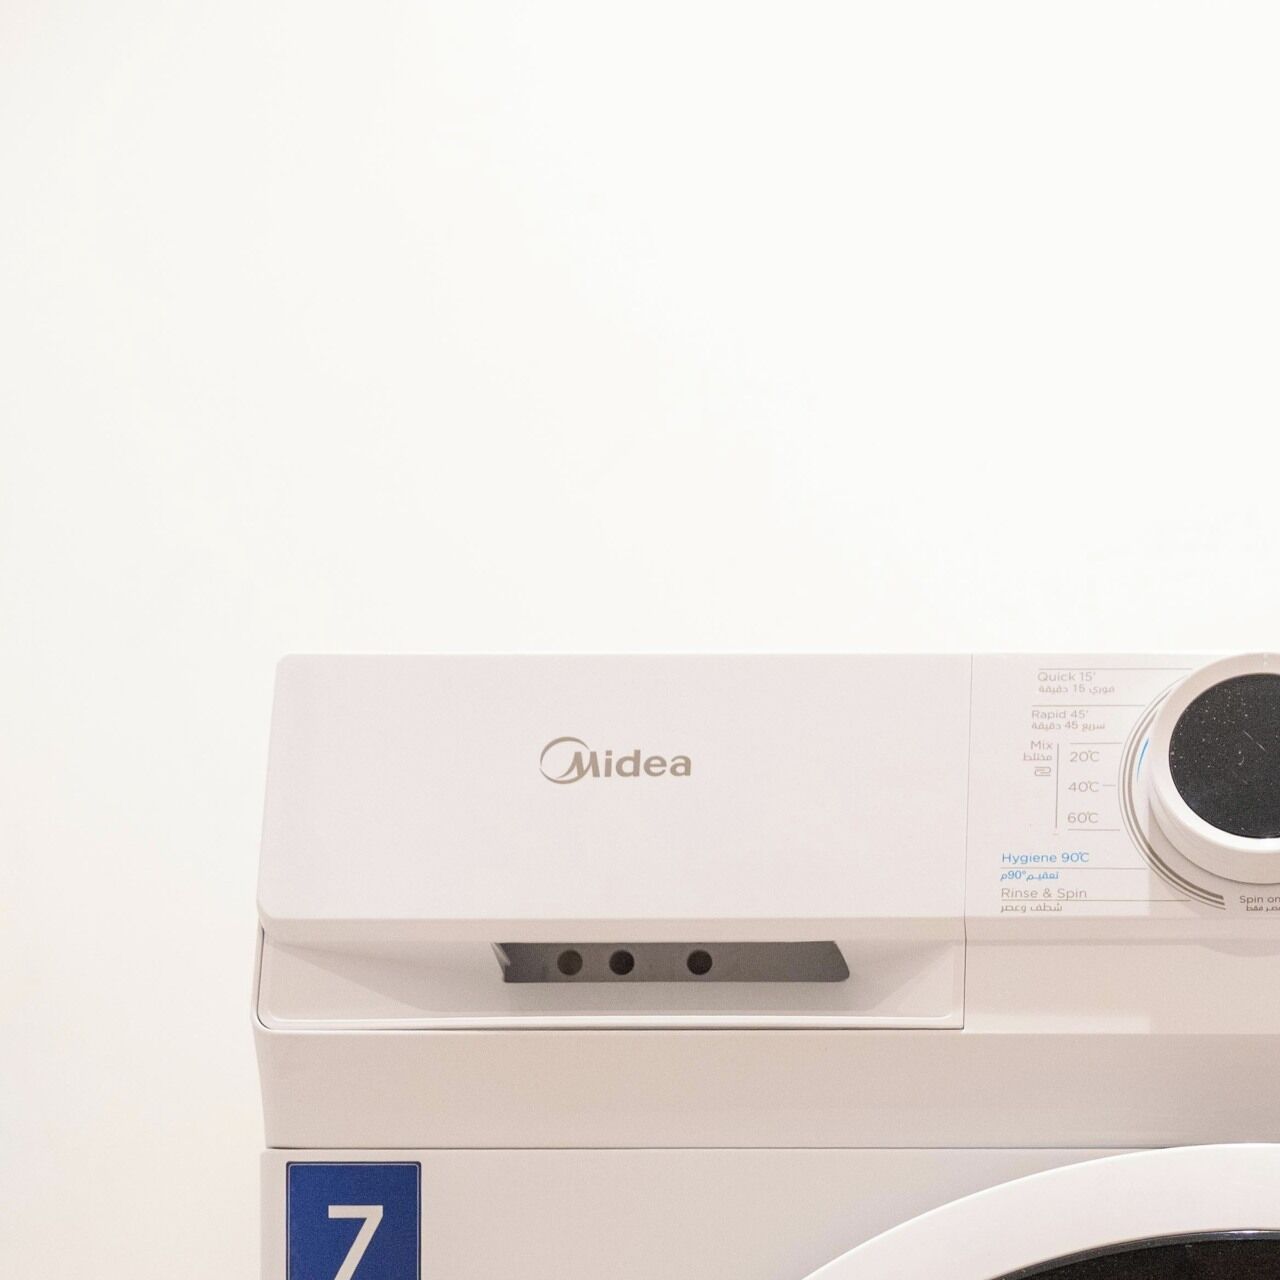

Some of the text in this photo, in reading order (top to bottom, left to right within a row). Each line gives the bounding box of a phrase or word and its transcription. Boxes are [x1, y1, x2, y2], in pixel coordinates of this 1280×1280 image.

[1037, 671, 1076, 682] Quick
[1073, 683, 1086, 693] 15
[1031, 709, 1067, 721] Rapid
[1064, 720, 1079, 730] 45
[1031, 740, 1053, 750] Mix
[539, 736, 692, 784] Midea
[1001, 852, 1057, 865] Hygiene
[1000, 887, 1088, 901] Rinse & Spin
[1239, 895, 1264, 904] Spin
[1030, 902, 1063, 912] شطف
